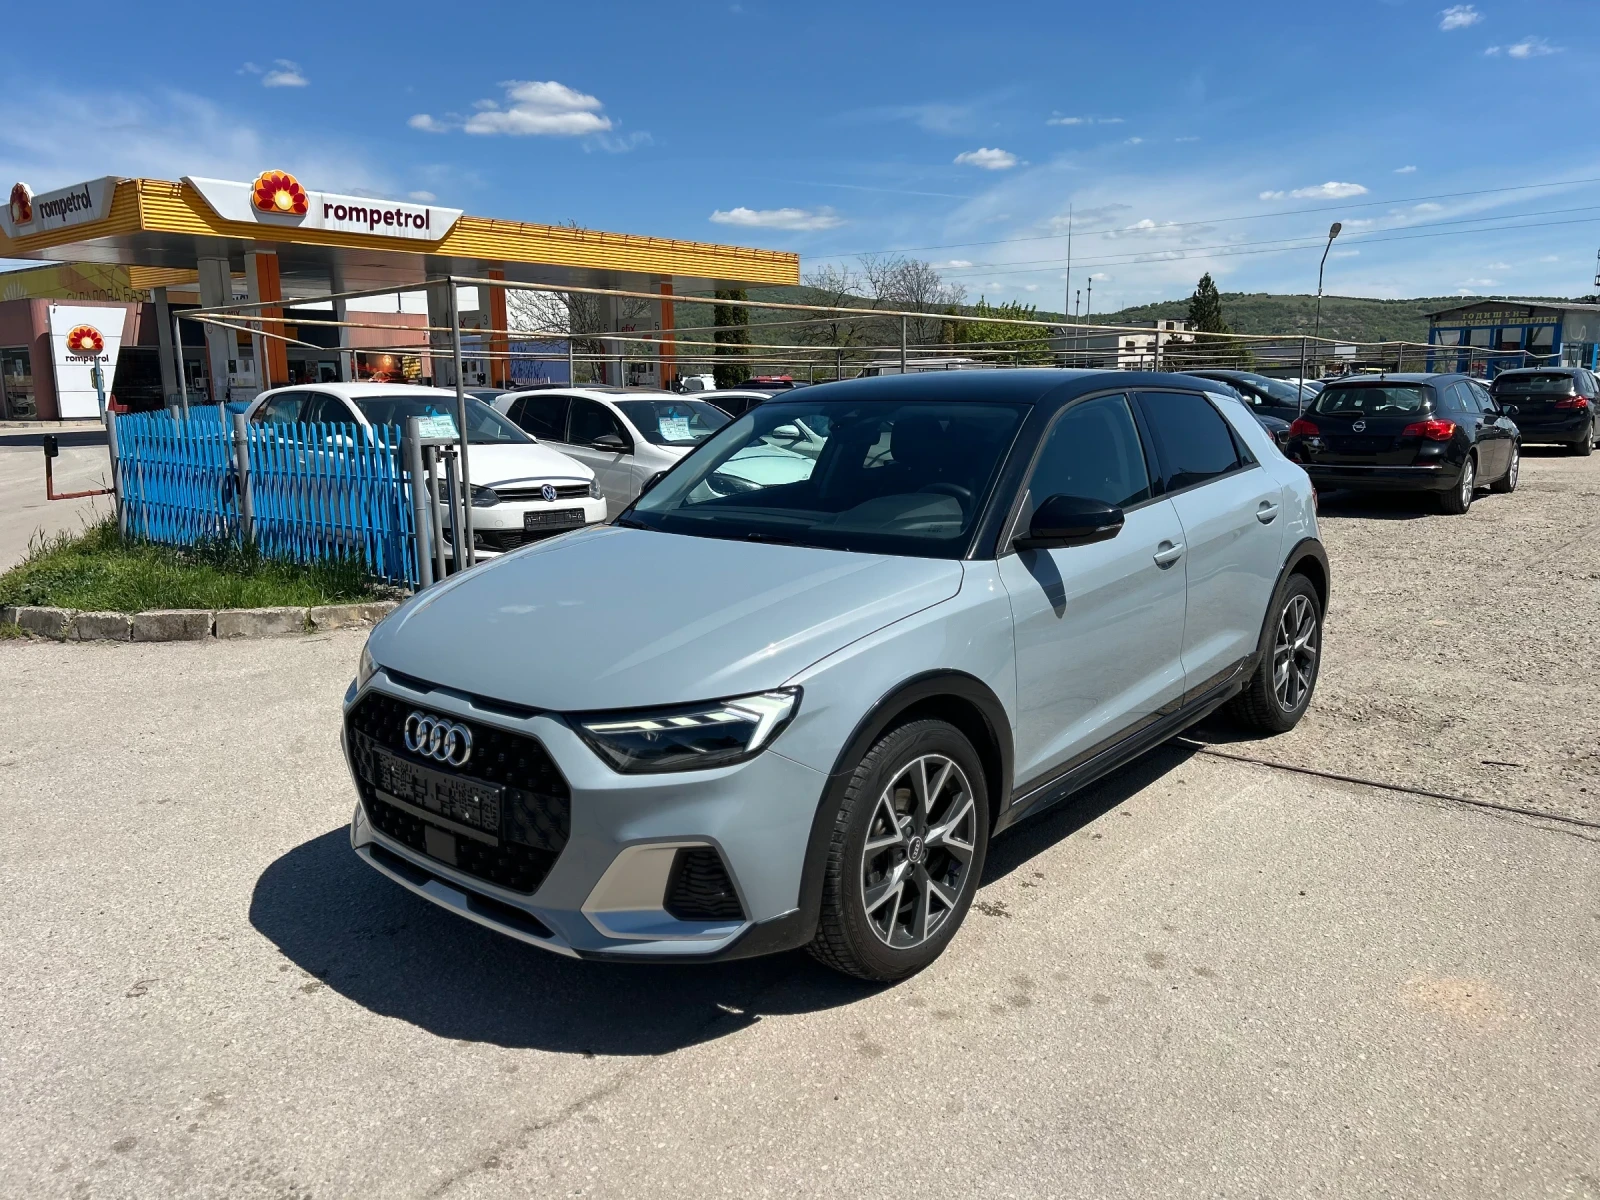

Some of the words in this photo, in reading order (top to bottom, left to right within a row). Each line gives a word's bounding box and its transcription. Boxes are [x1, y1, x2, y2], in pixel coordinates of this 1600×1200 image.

[39, 184, 92, 222] rompetrol
[323, 202, 430, 231] rompetrol
[482, 313, 489, 326] 3
[1508, 316, 1558, 325] ПРЕГЛЕД
